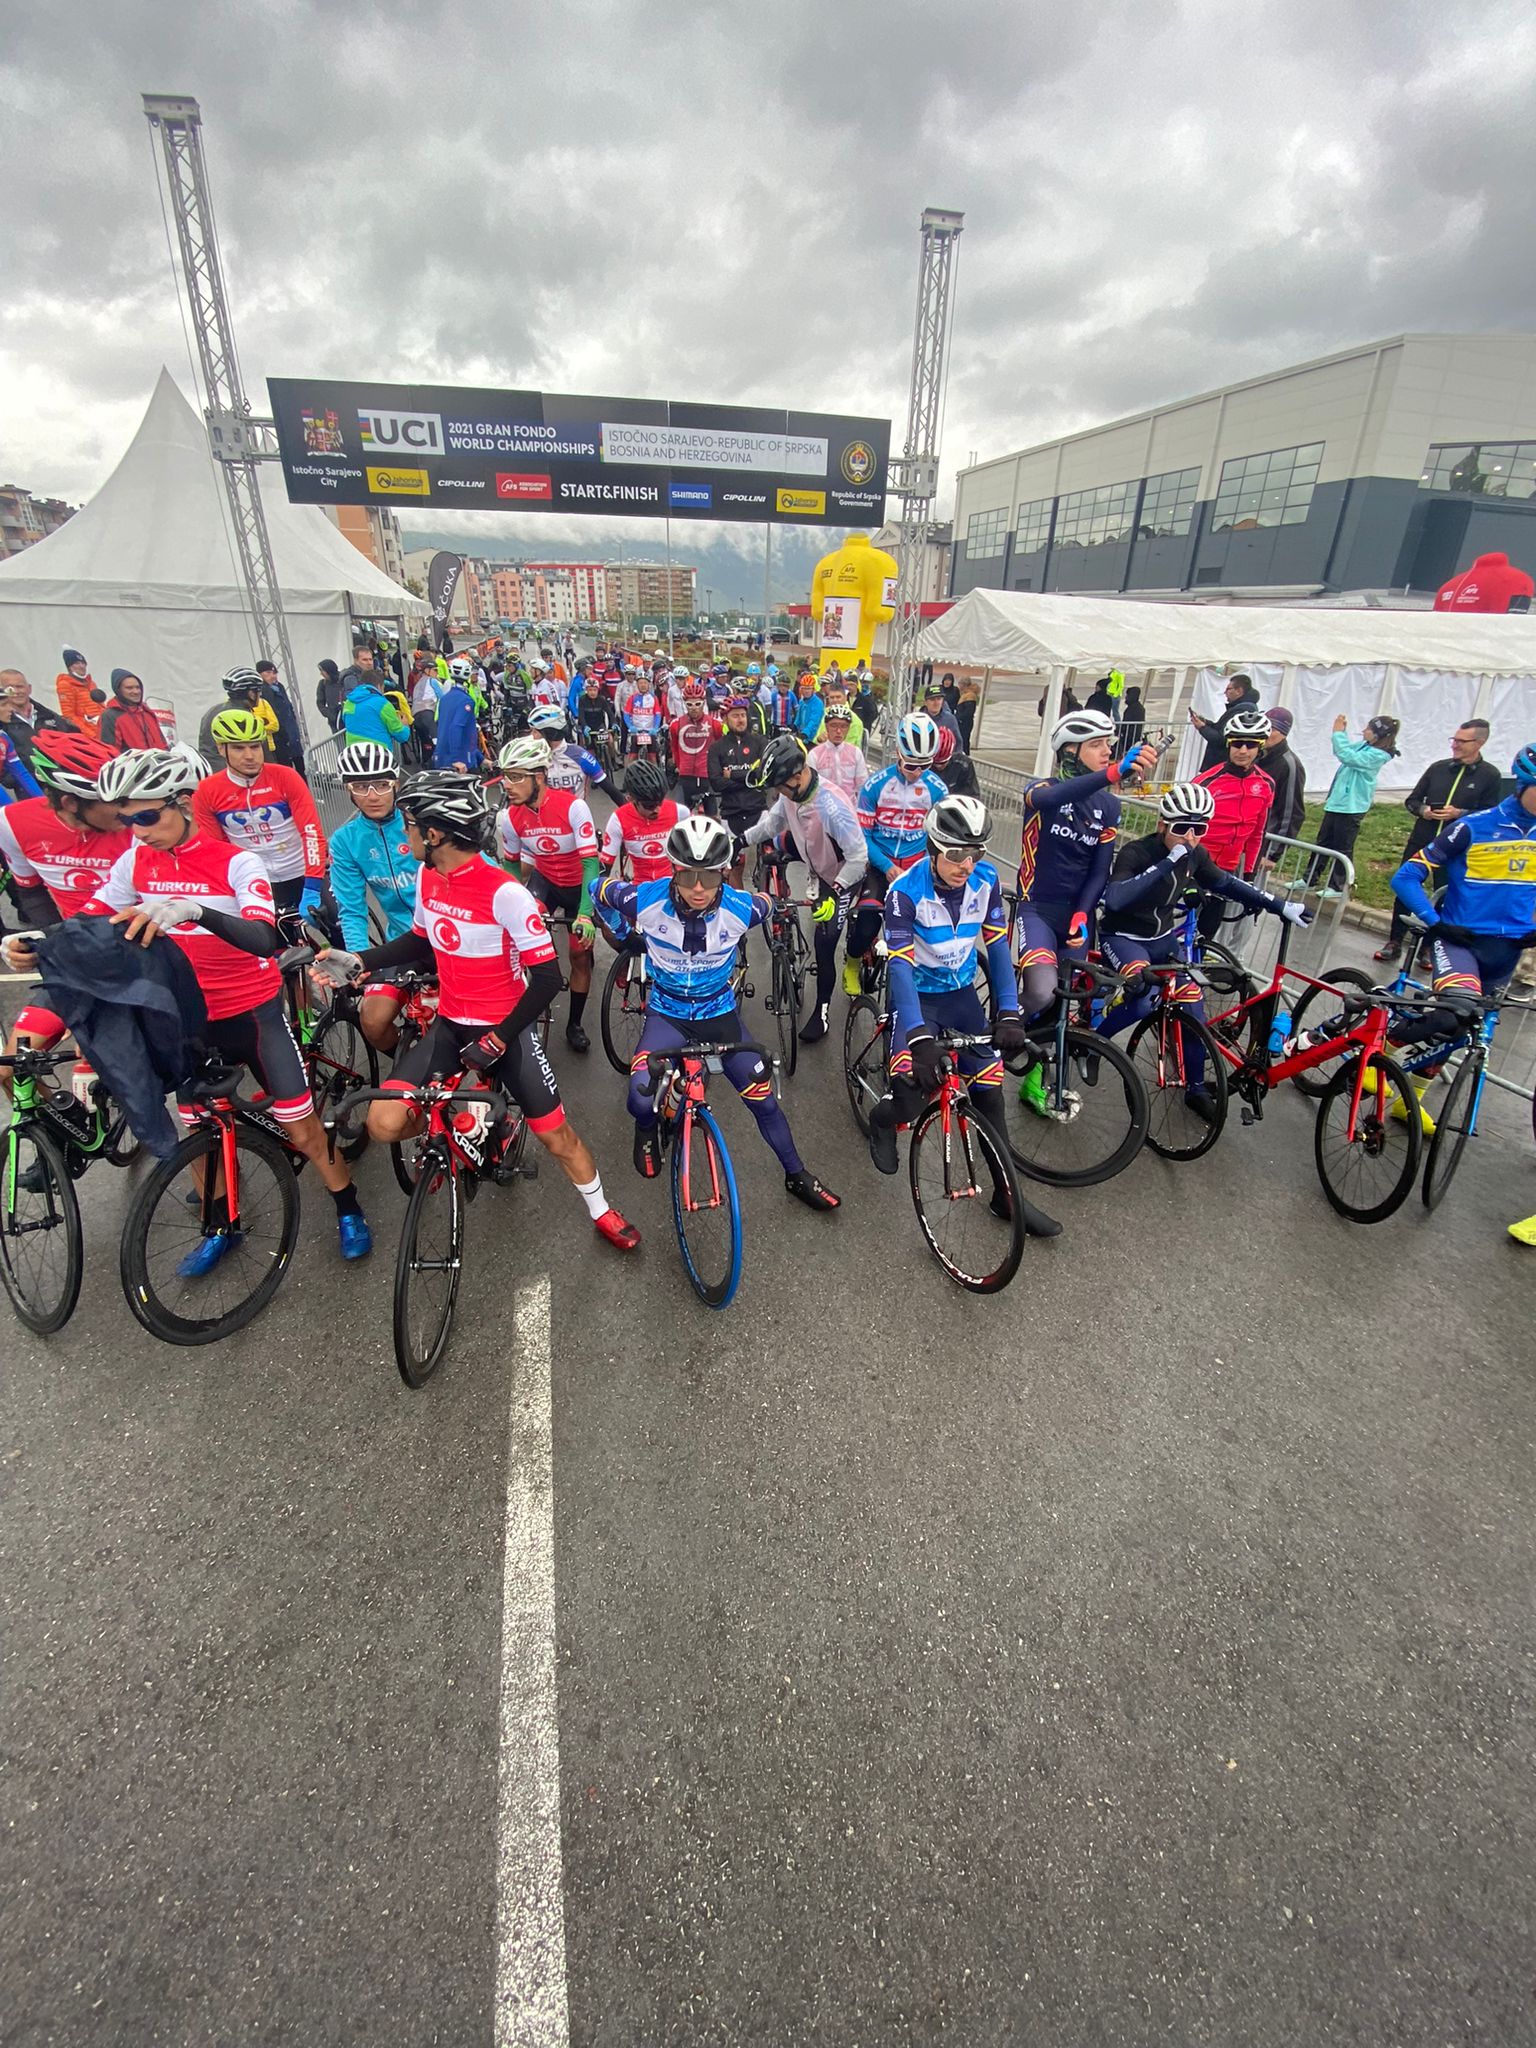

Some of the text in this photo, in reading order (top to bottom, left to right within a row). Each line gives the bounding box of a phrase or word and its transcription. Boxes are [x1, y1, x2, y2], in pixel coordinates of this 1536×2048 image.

[373, 417, 438, 448] UCI
[448, 422, 556, 438] 2021 GRAN FONDO
[449, 437, 595, 455] WORLD CHAMPIONSHIPS
[608, 430, 658, 444] ISTOČNO
[767, 440, 782, 452] OF
[784, 442, 823, 455] SRPSKA
[610, 445, 753, 463] BOSNIA AND HERZEGOVINA
[292, 465, 362, 478] Istočno Sarajevo
[320, 477, 337, 488] City
[437, 479, 485, 488] CIPOLLINI
[560, 483, 659, 500] START&FINISH
[671, 490, 709, 500] SHIMANO
[722, 494, 767, 503] CIPOLLINI
[831, 490, 856, 500] Republic
[863, 493, 882, 502] Srpska
[441, 567, 457, 606] ČOKA
[547, 775, 584, 787] ERBIA
[530, 1032, 559, 1095] TÜRKİYE
